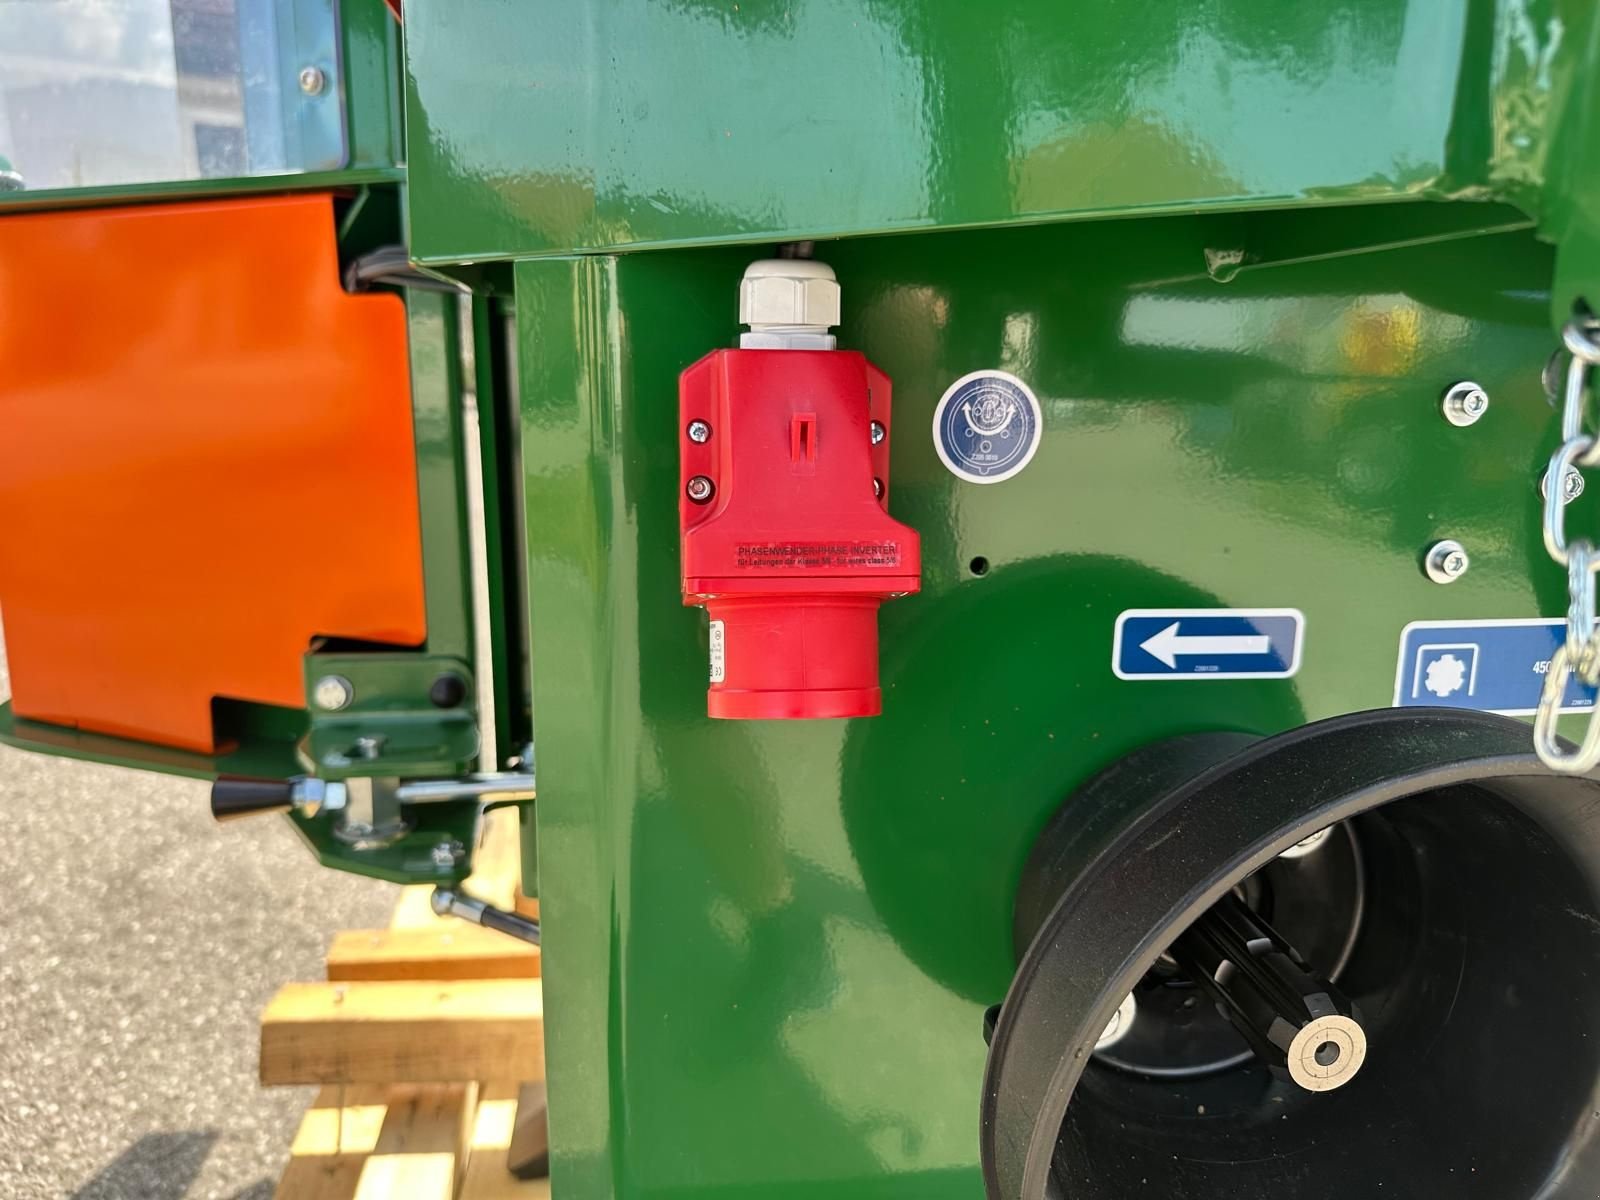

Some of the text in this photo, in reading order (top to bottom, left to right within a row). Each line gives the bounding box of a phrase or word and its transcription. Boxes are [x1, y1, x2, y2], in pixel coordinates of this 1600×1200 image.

[850, 545, 896, 555] INVERTER
[737, 558, 748, 566] für
[749, 558, 783, 568] Leitungen
[784, 558, 796, 566] der
[867, 556, 885, 565] class
